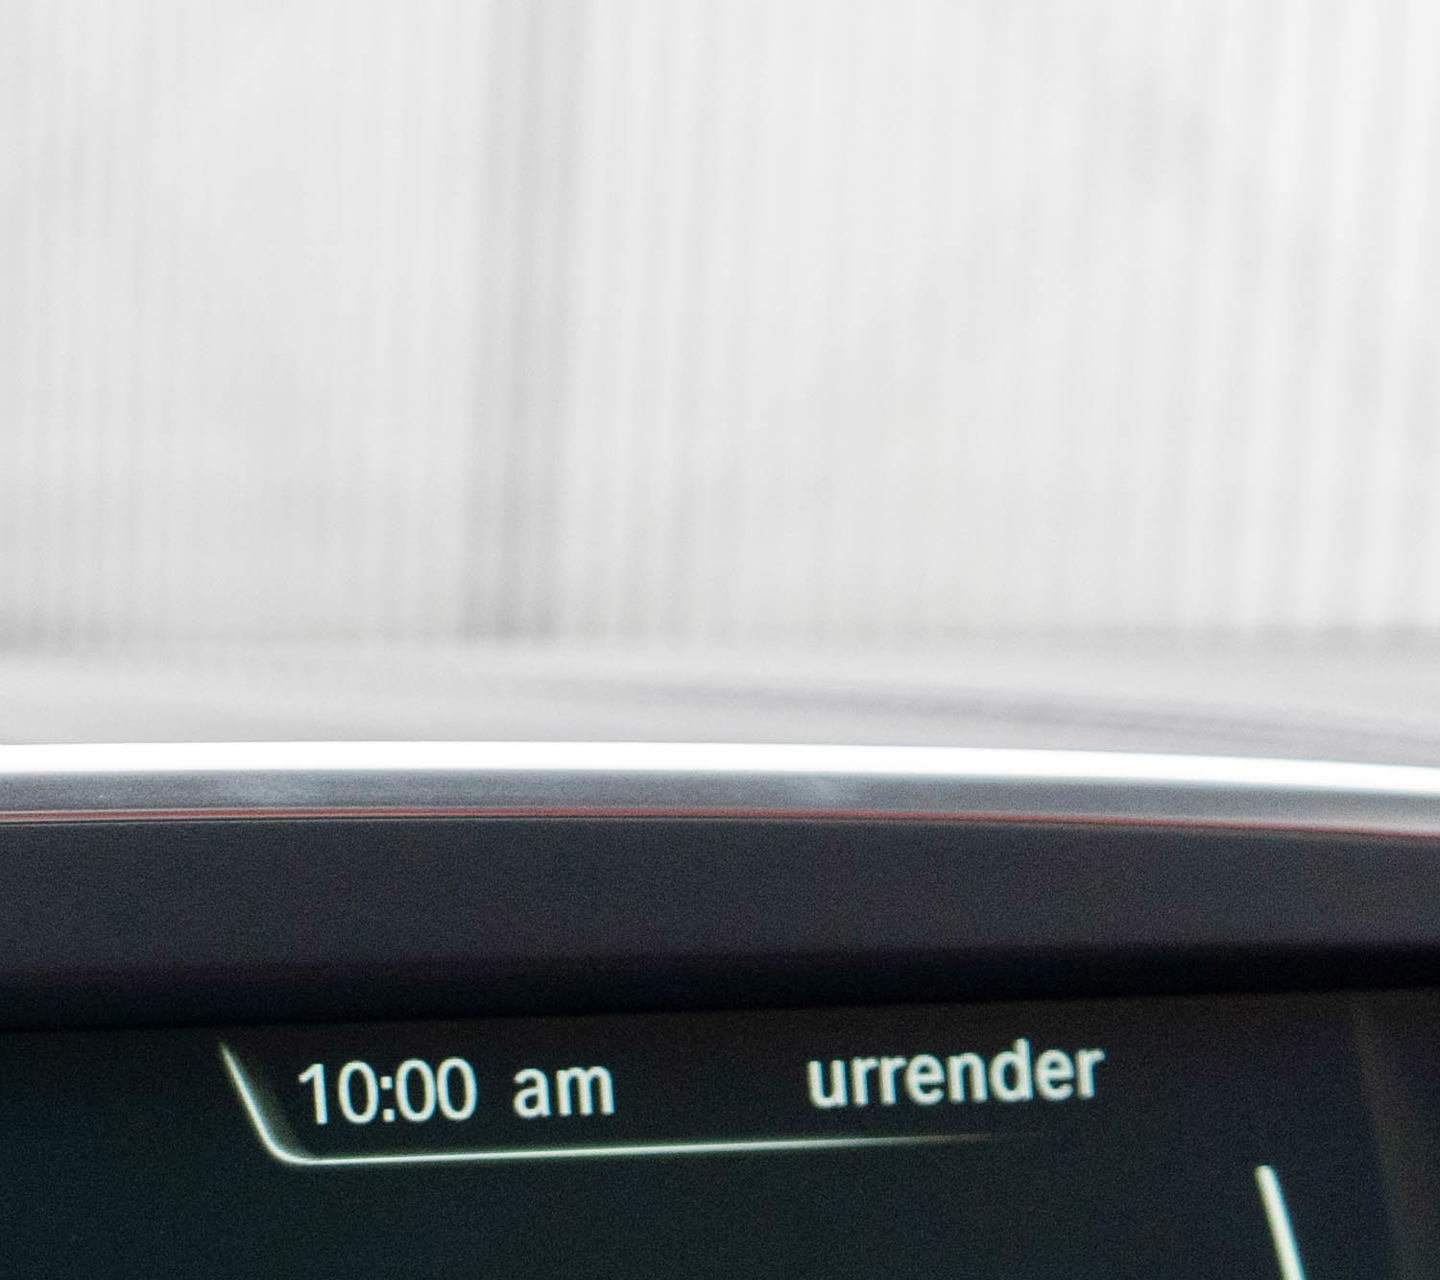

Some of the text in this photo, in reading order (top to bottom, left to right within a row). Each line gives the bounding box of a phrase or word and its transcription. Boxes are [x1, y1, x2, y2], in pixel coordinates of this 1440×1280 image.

[298, 1057, 613, 1125] 10:00 am
[808, 1038, 1104, 1108] urrender
